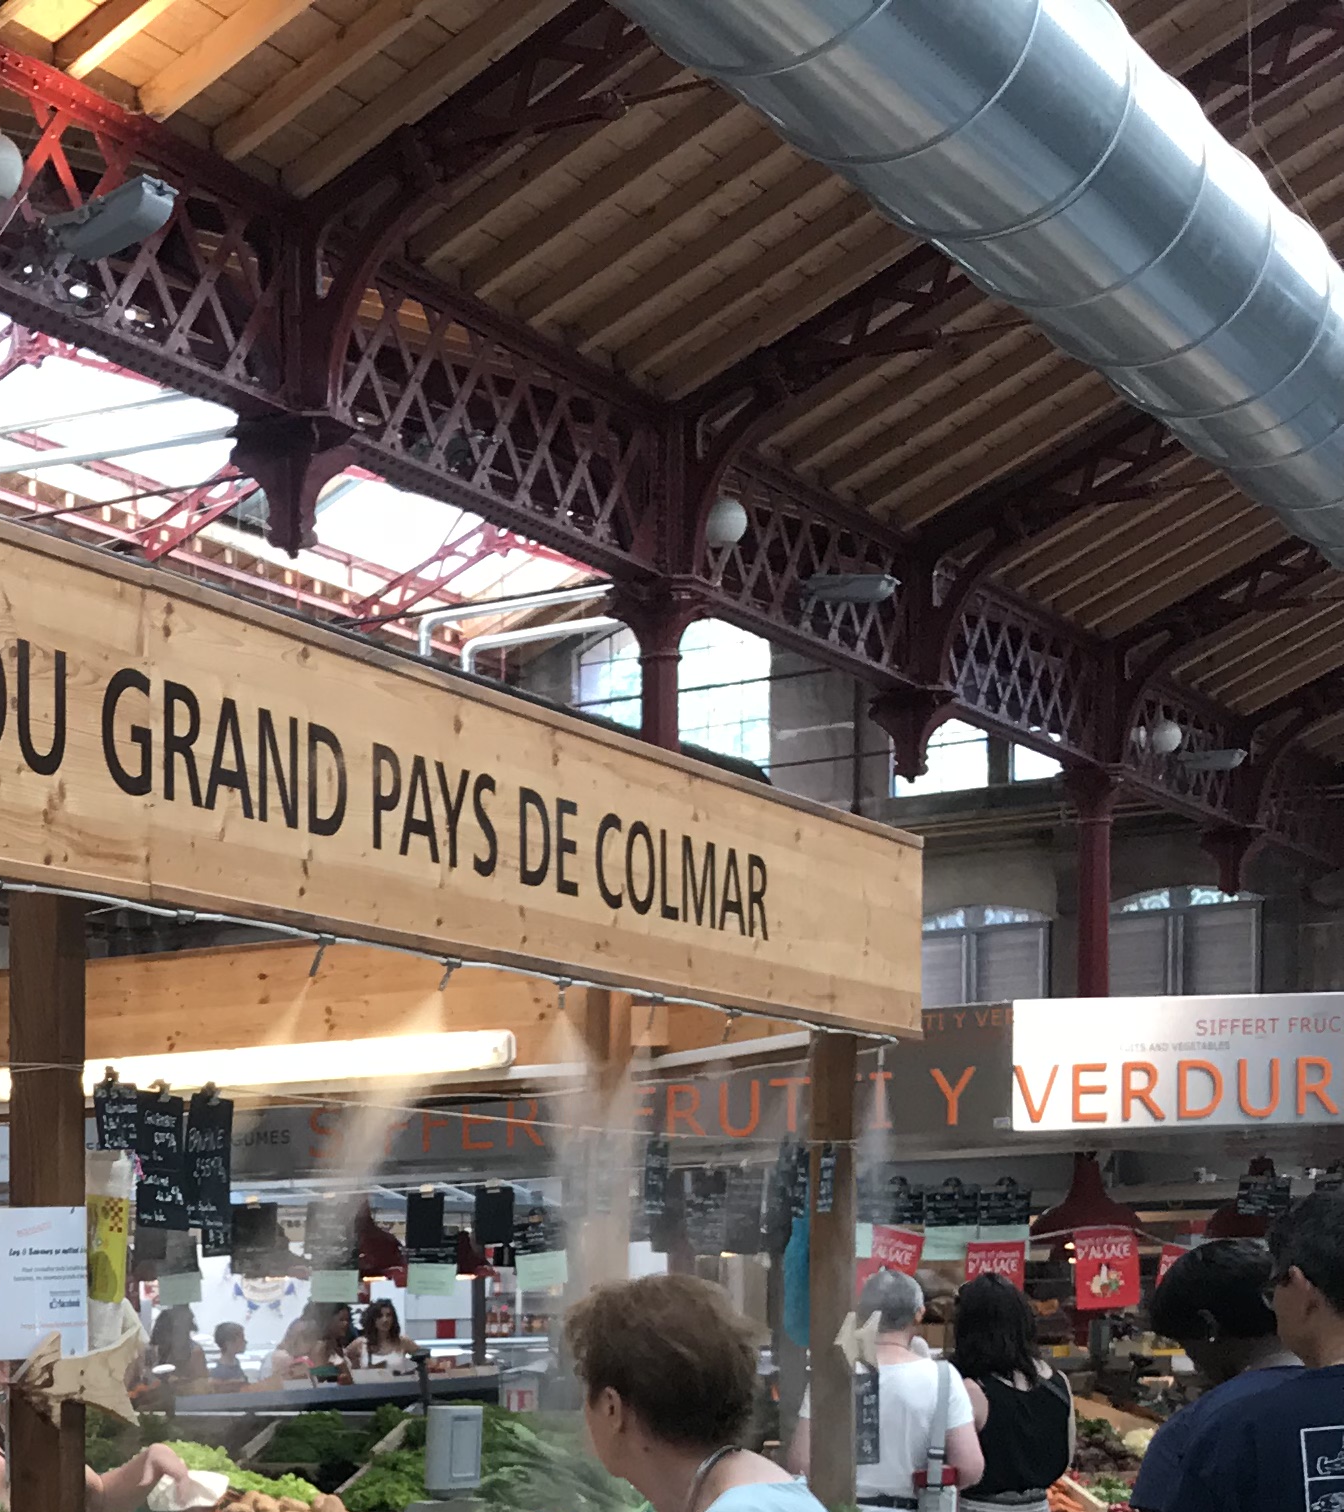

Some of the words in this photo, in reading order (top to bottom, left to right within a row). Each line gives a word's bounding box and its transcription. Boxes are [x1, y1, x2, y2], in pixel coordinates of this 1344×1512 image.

[101, 667, 348, 836] GRAND
[372, 742, 498, 878] PAYS
[518, 786, 580, 898] DE
[595, 812, 771, 942] COLMAR
[1196, 1018, 1280, 1037] SIFFERT
[928, 1065, 978, 1128] Y
[1076, 1243, 1131, 1260] D'ALSACE
[968, 1258, 1018, 1274] D'ALSACE
